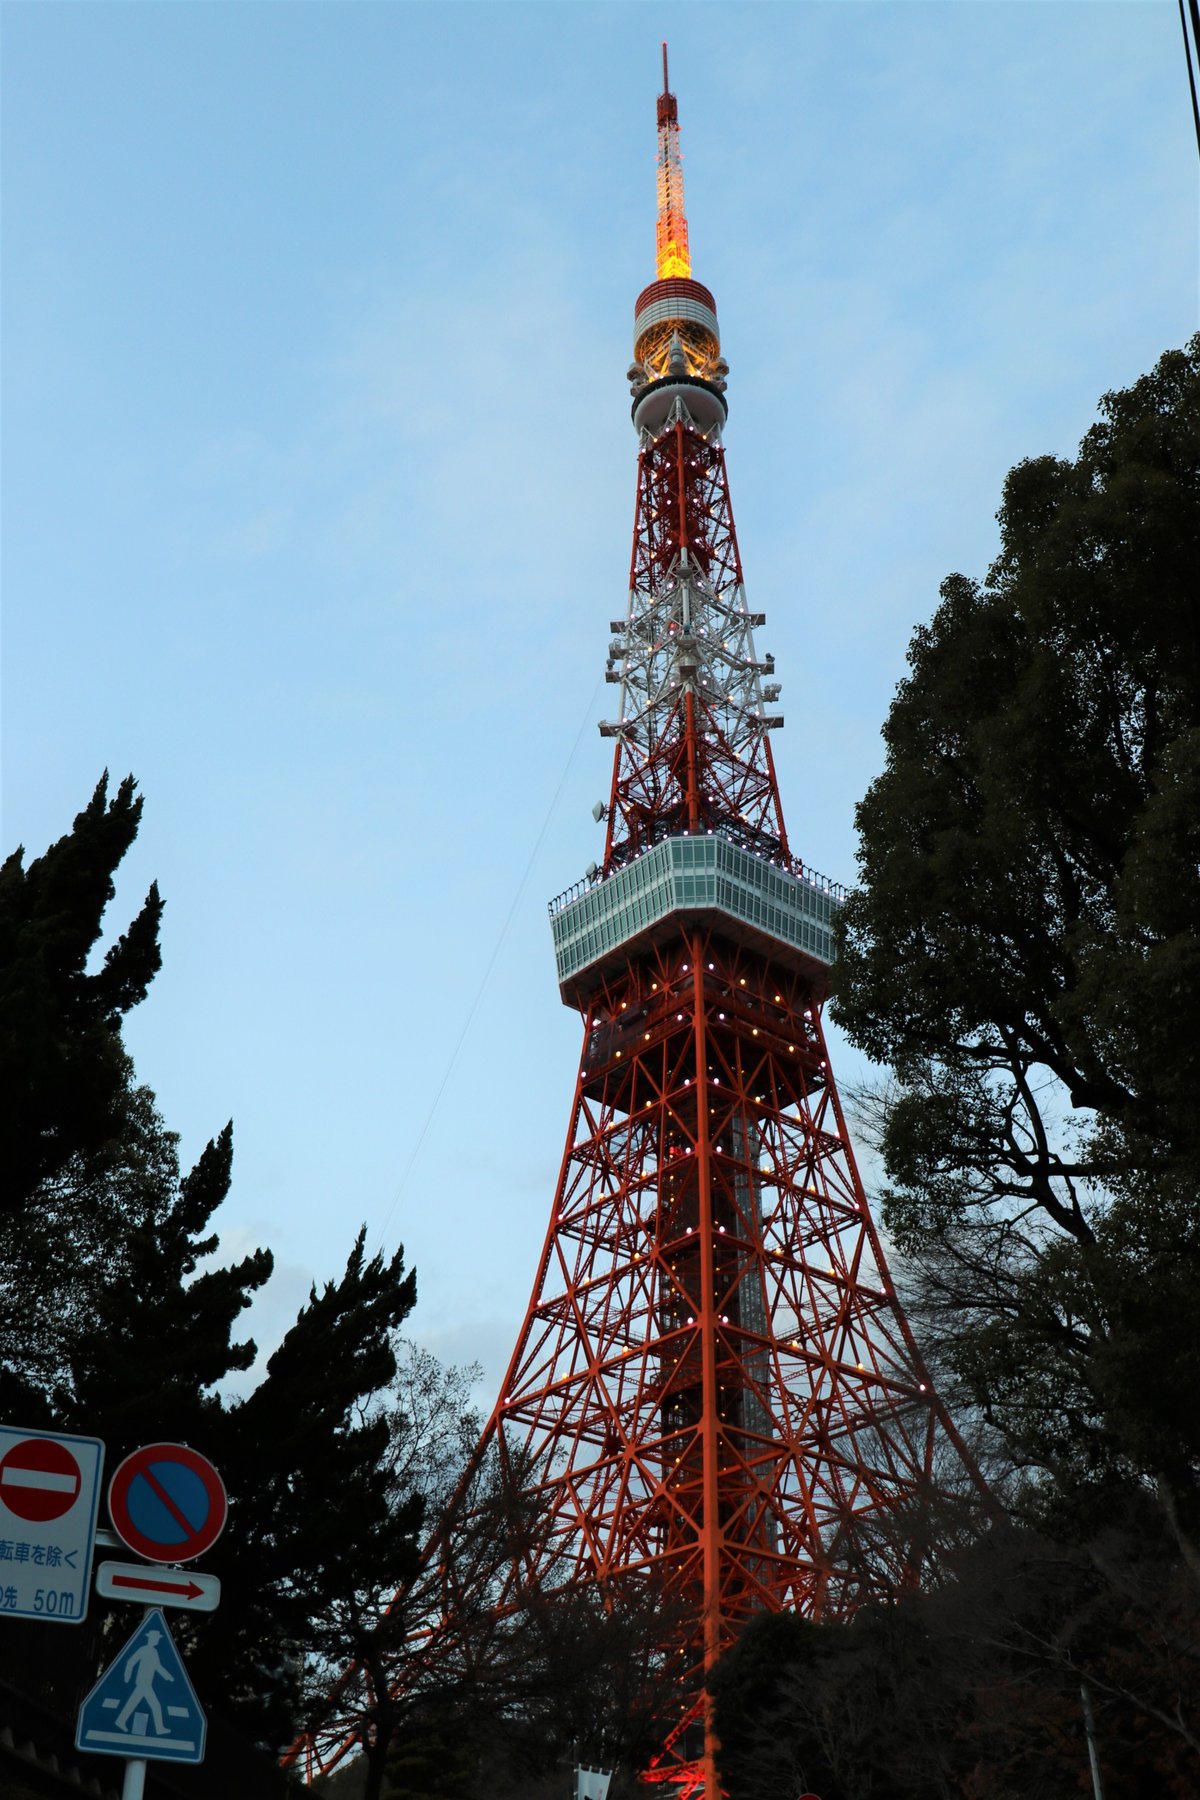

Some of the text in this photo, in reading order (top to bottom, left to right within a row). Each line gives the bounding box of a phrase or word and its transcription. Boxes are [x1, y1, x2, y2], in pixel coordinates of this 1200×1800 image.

[0, 1540, 78, 1569] 転車を除く
[0, 1586, 74, 1614] 先 50m
